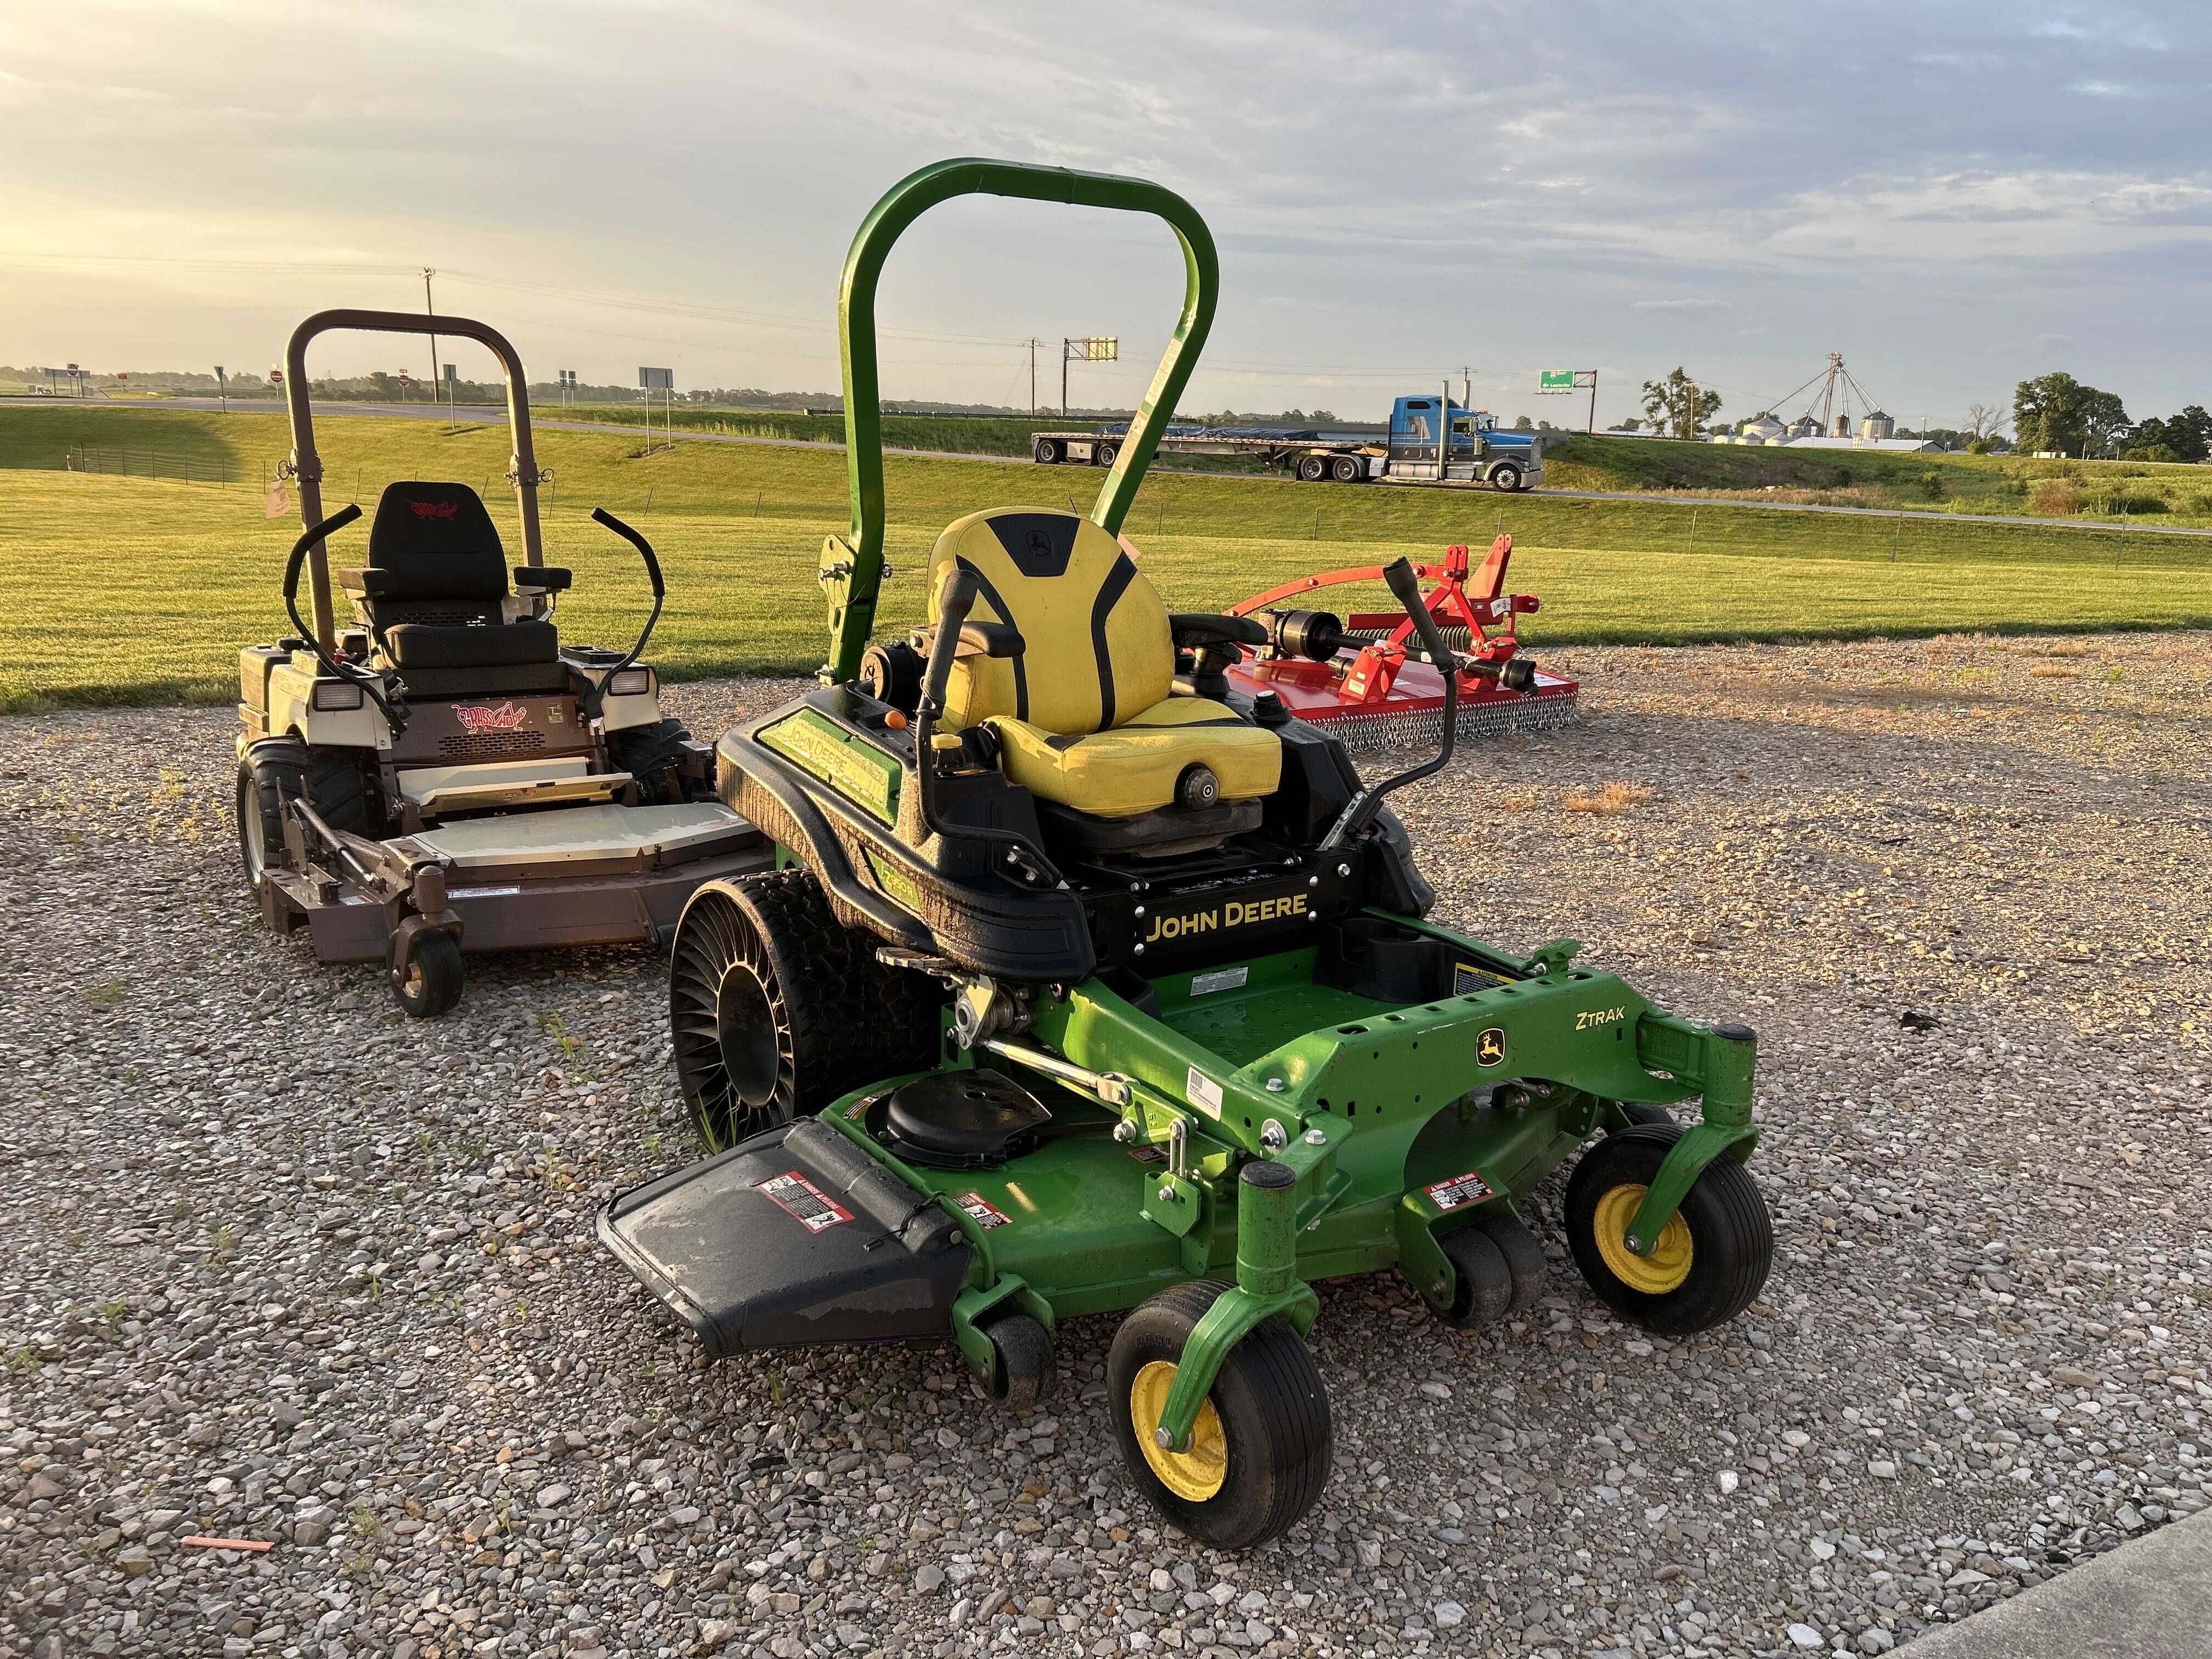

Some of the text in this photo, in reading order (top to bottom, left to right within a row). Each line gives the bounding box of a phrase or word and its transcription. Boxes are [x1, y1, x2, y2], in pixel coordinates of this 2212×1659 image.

[786, 727, 848, 773] JOHN DEERE
[1146, 893, 1308, 942] JOHN DEERE
[1575, 1005, 1625, 1031] ZTRAK
[1136, 1333, 1182, 1352] CARLI
